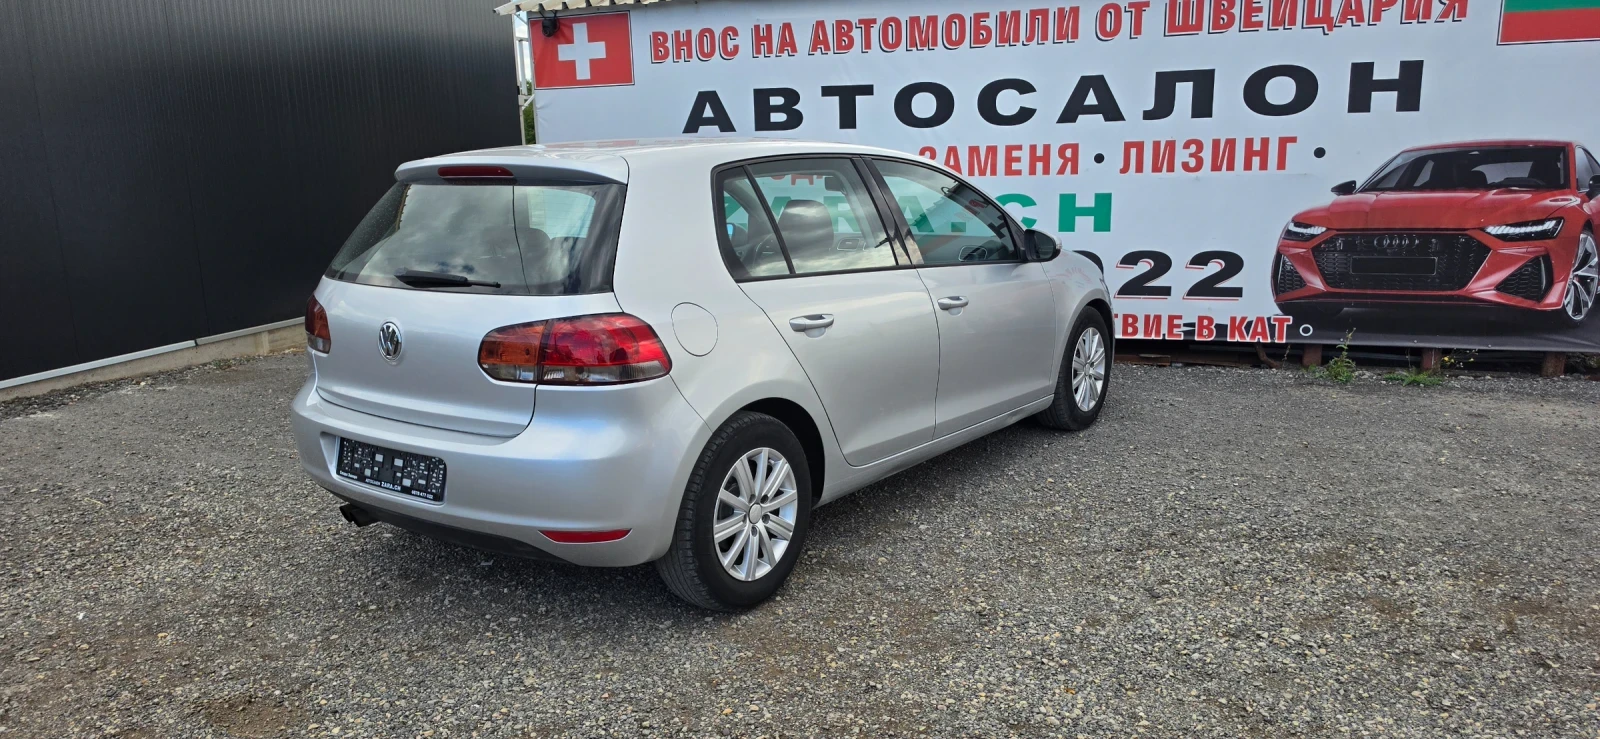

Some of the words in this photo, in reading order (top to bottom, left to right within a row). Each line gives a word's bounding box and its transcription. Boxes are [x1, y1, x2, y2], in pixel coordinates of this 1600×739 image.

[650, 27, 740, 64] ВНОС
[752, 22, 798, 58] НА
[808, 3, 1080, 56] АВТОМОБИЛИ
[1095, 1, 1150, 42] ОТ
[682, 60, 1424, 134] АВТОСАЛОН
[1120, 135, 1298, 174] ЛИЗИНГ
[1072, 249, 1245, 301] 22
[1113, 313, 1184, 340] ВИЕ
[1195, 314, 1217, 341] В
[1227, 315, 1294, 344] КАТ
